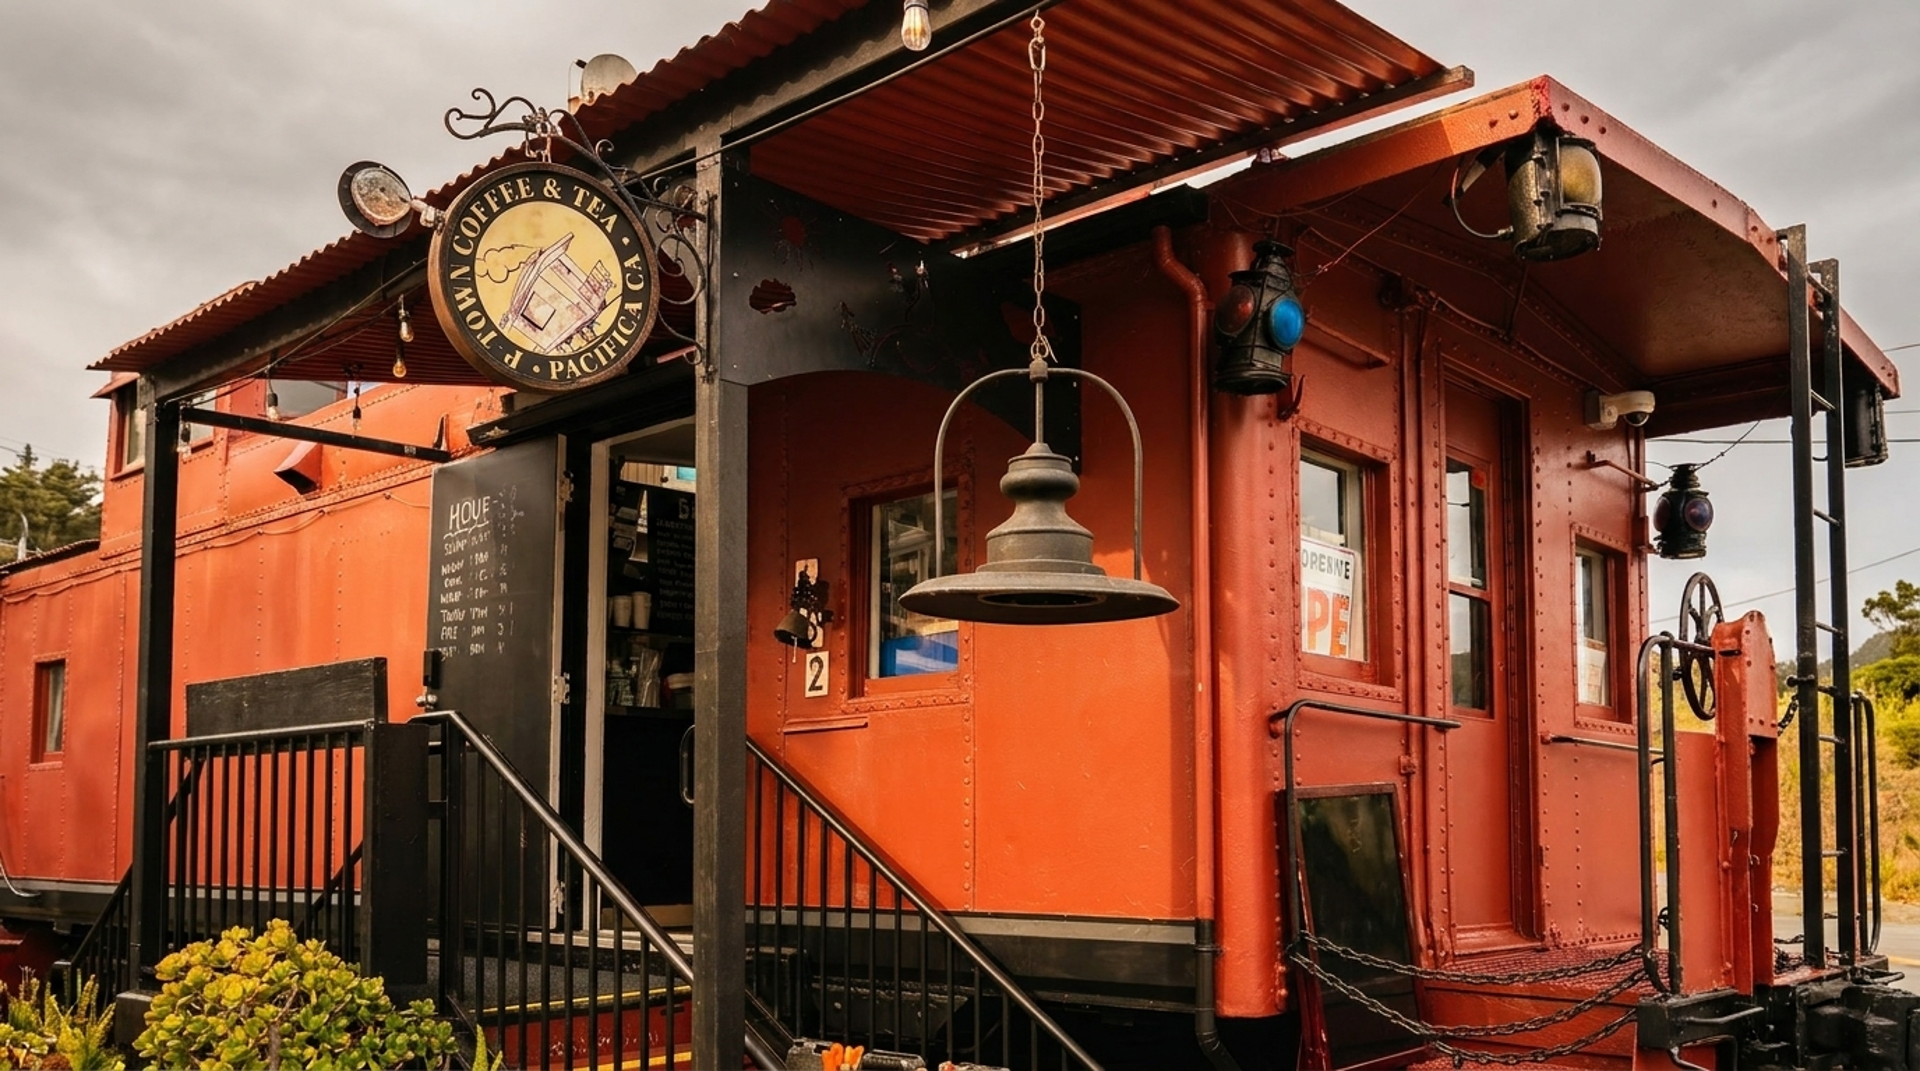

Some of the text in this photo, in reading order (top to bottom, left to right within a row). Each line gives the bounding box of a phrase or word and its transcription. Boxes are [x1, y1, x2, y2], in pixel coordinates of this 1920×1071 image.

[452, 177, 535, 257] COFFEE
[543, 178, 562, 200] &
[572, 184, 619, 234] TEA
[549, 253, 645, 380] PACIFICA CA
[808, 655, 824, 692] 2
